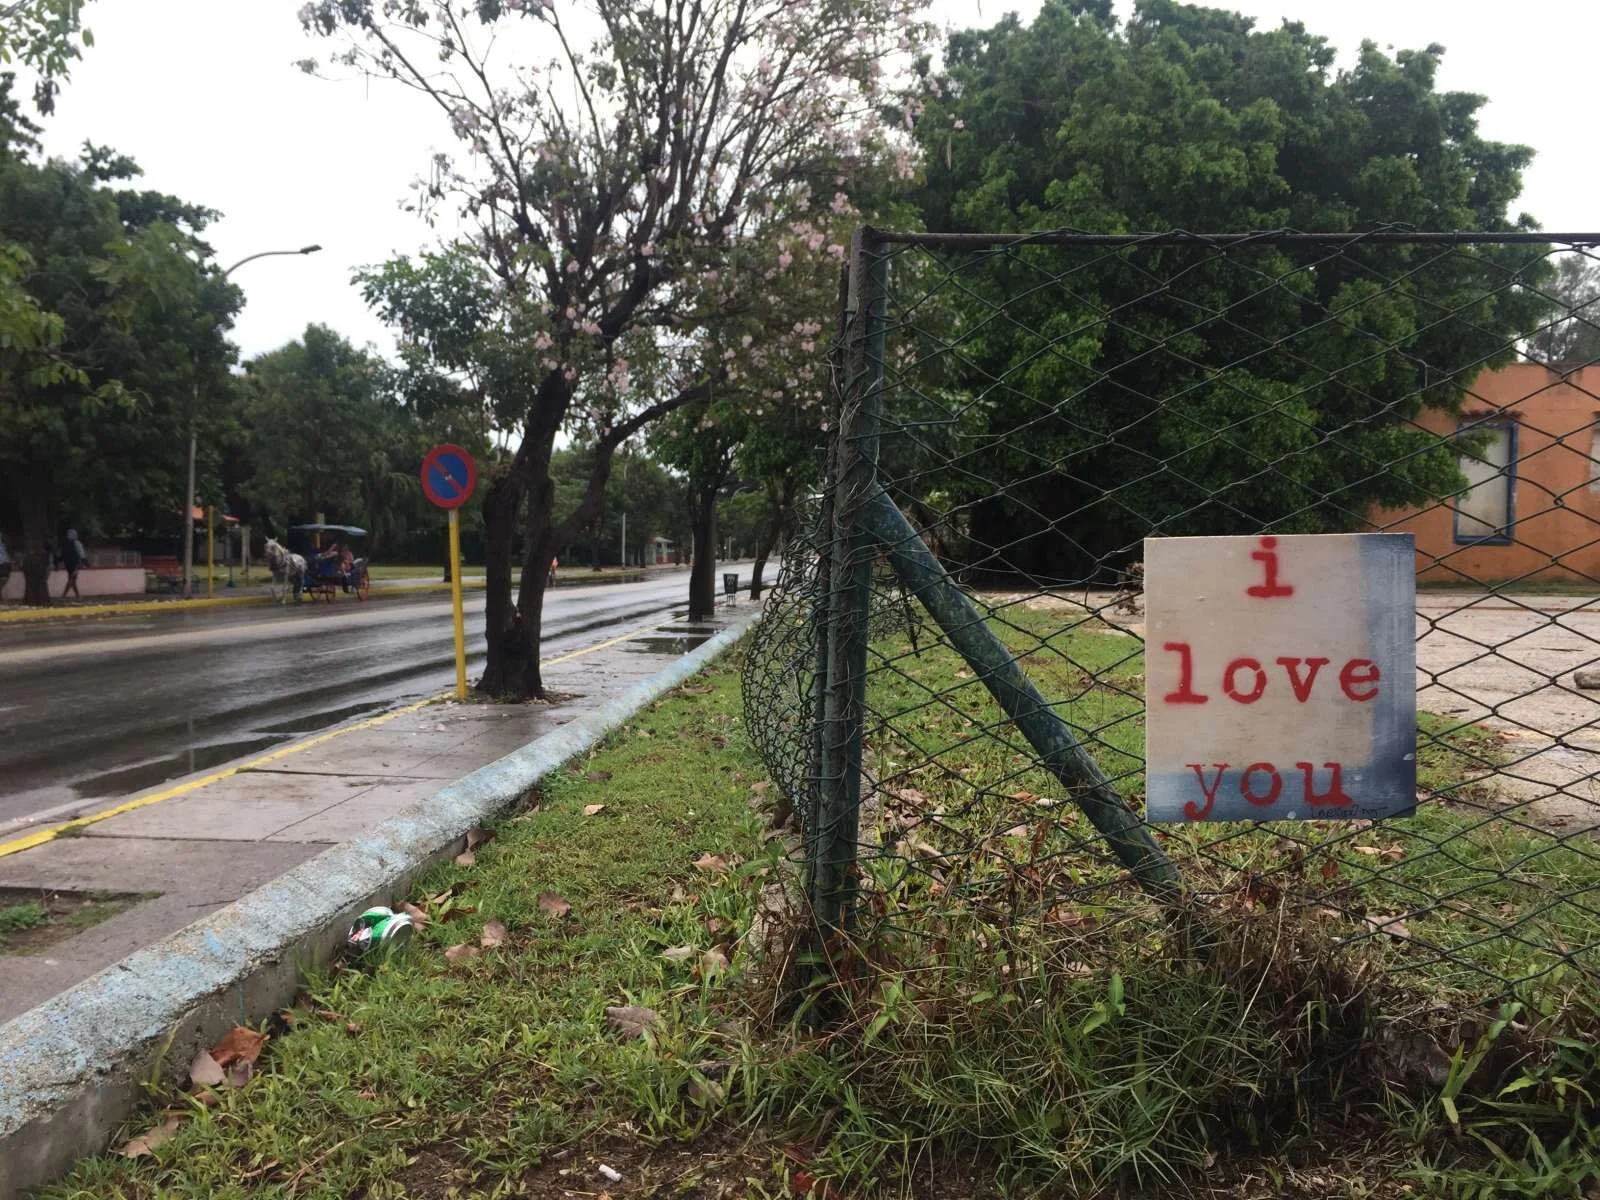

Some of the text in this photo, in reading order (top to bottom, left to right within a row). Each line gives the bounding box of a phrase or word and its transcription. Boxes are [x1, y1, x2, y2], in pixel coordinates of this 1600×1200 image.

[1246, 536, 1294, 598] i
[1163, 642, 1380, 704] love
[1184, 761, 1353, 821] you
